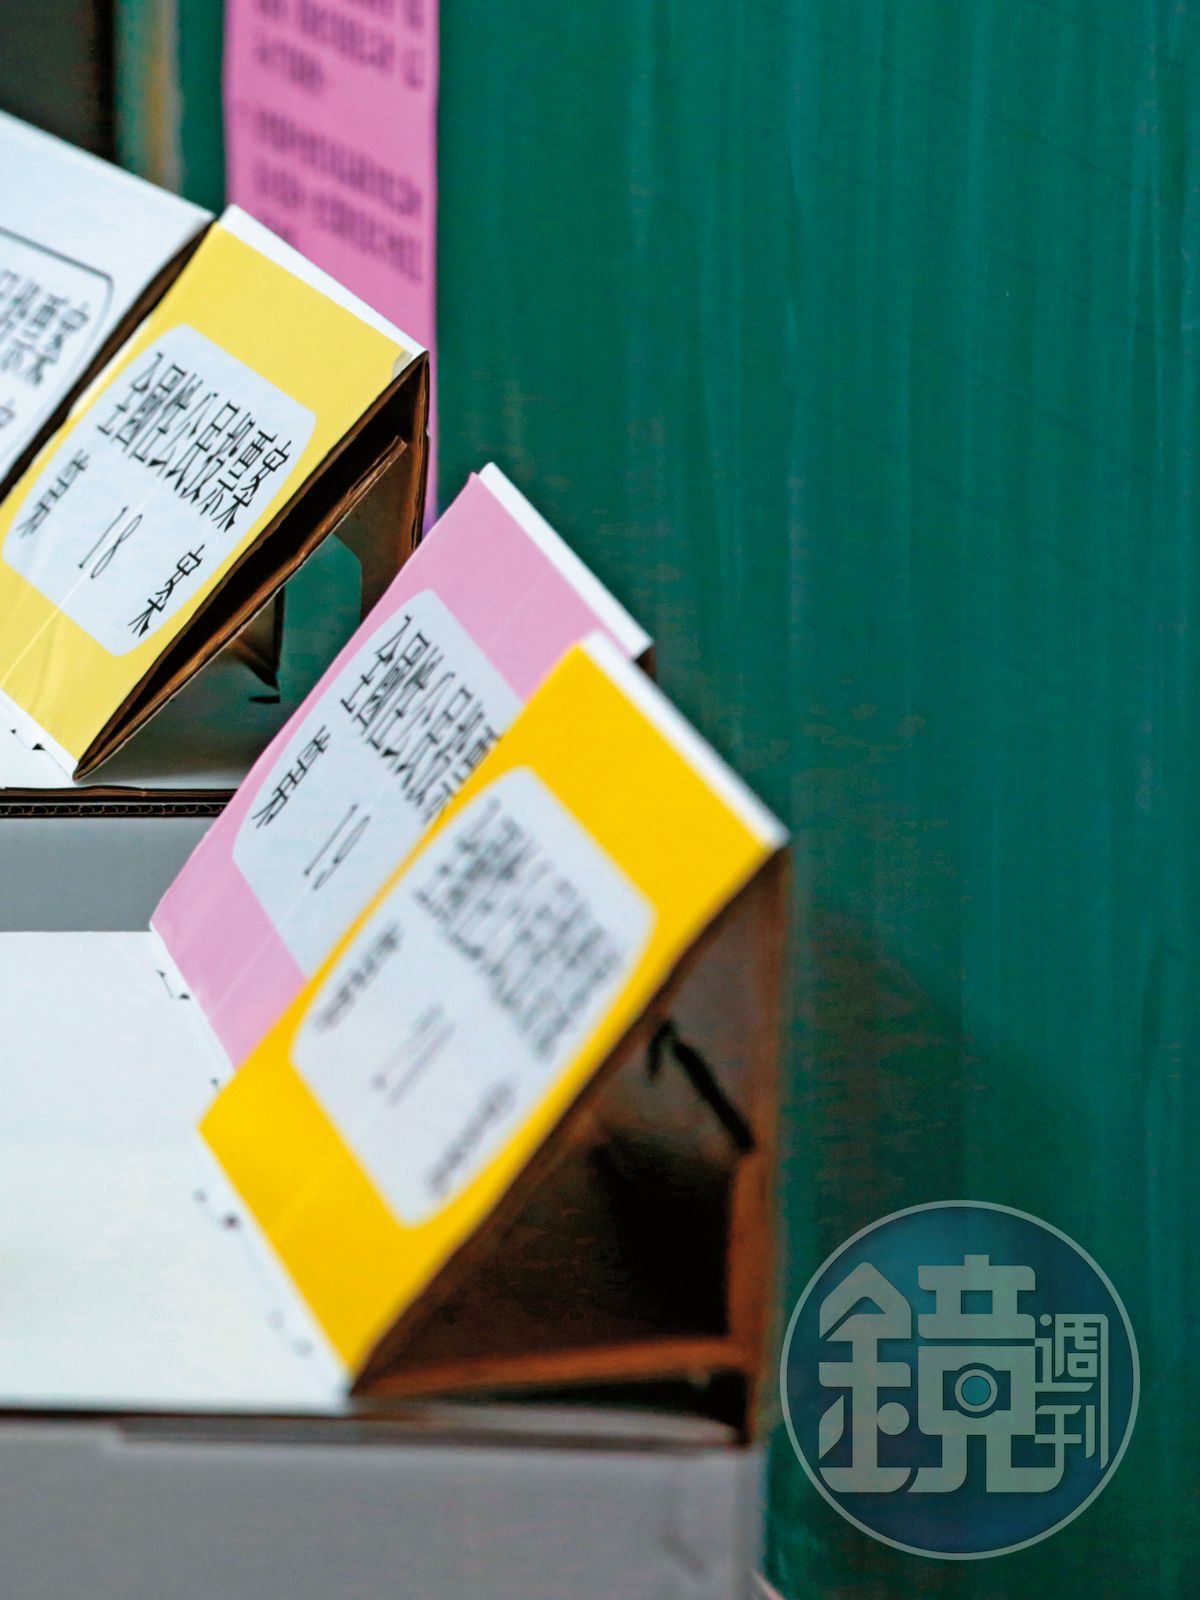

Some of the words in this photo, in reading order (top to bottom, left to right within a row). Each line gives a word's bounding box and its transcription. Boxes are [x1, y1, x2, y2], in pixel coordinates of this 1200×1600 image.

[96, 352, 291, 533] 全國性公民投票案
[18, 450, 89, 536] 第
[77, 505, 143, 579] 18
[128, 543, 205, 636] 案
[251, 726, 330, 828] 第
[303, 804, 370, 891] 19
